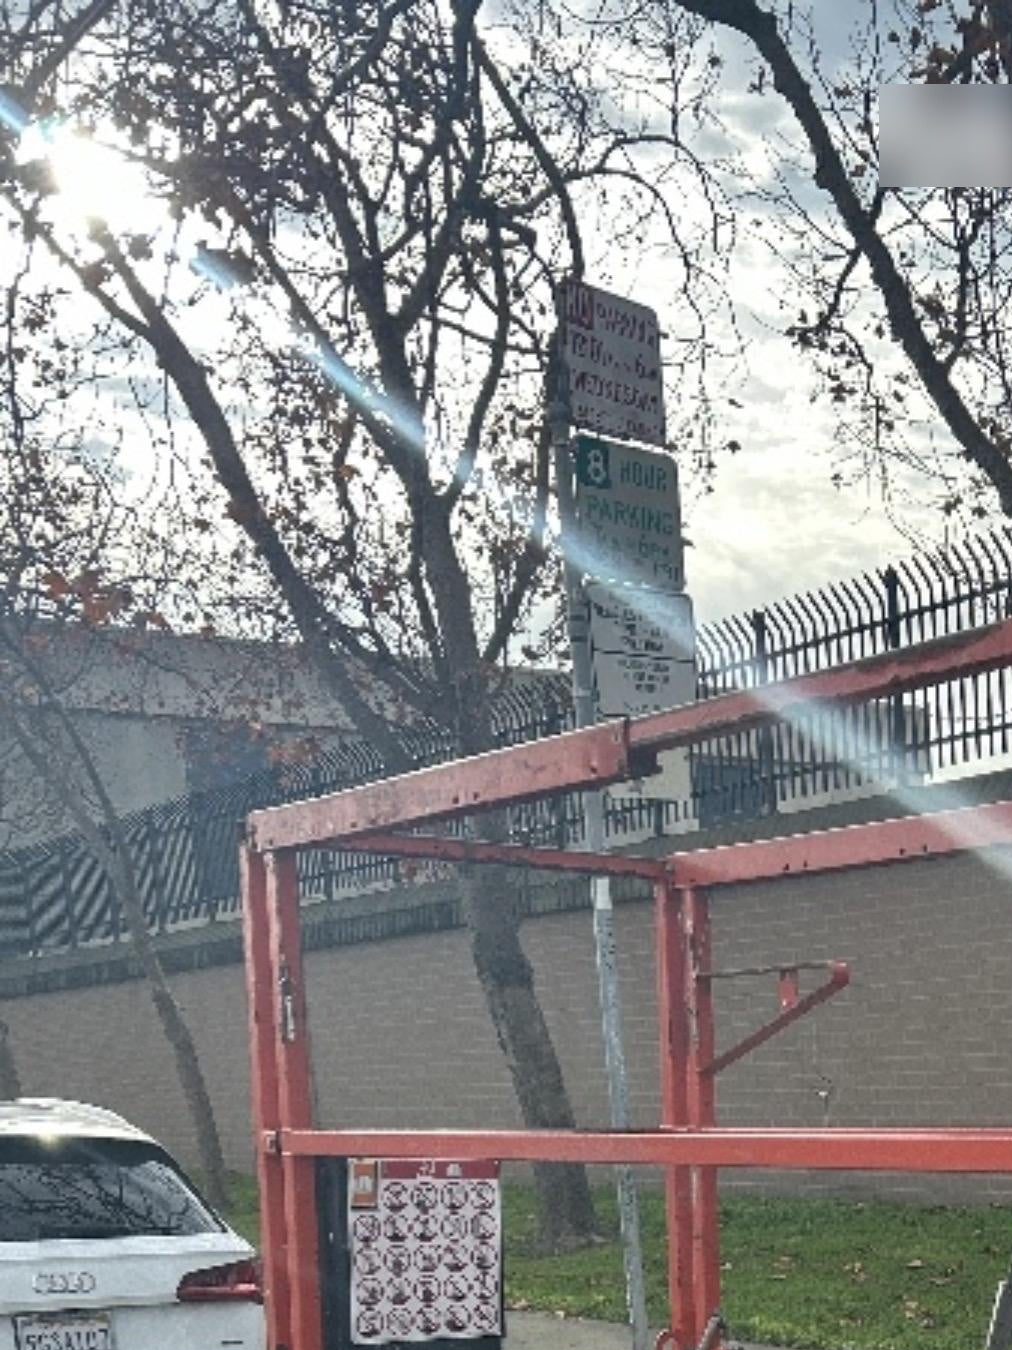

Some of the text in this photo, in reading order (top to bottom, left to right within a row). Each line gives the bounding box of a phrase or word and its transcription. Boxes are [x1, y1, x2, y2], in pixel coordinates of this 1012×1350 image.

[586, 449, 668, 493] 8 HOUR
[583, 496, 674, 535] PARKING
